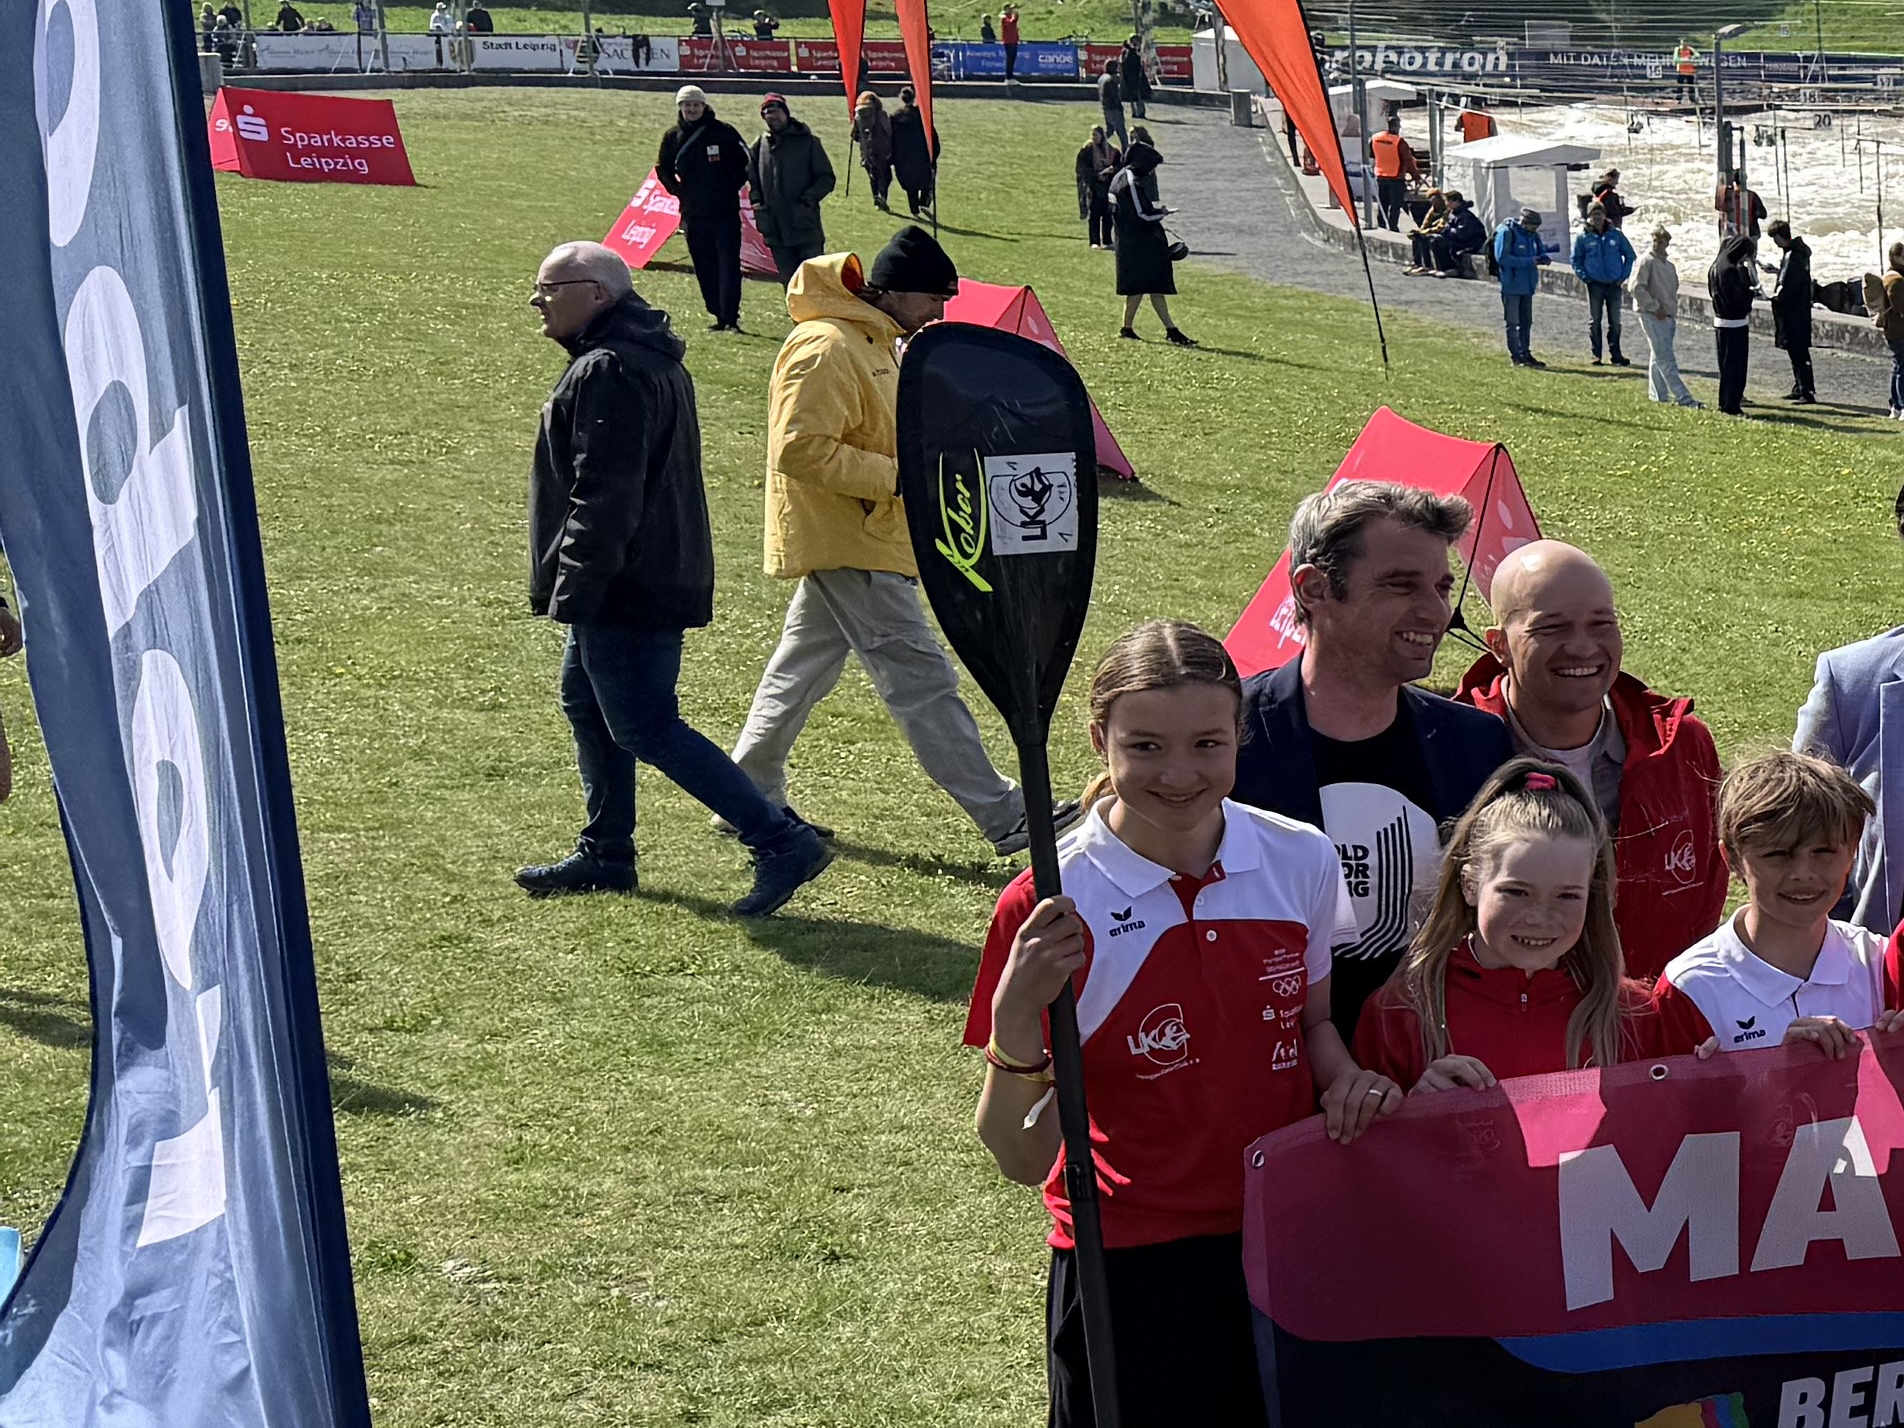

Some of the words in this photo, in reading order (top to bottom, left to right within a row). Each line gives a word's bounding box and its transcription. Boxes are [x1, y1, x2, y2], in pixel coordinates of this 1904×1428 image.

[1815, 113, 1833, 128] 20
[281, 127, 395, 150] Sparkasse
[286, 151, 369, 174] Leipzig
[1733, 1027, 1767, 1044] erima
